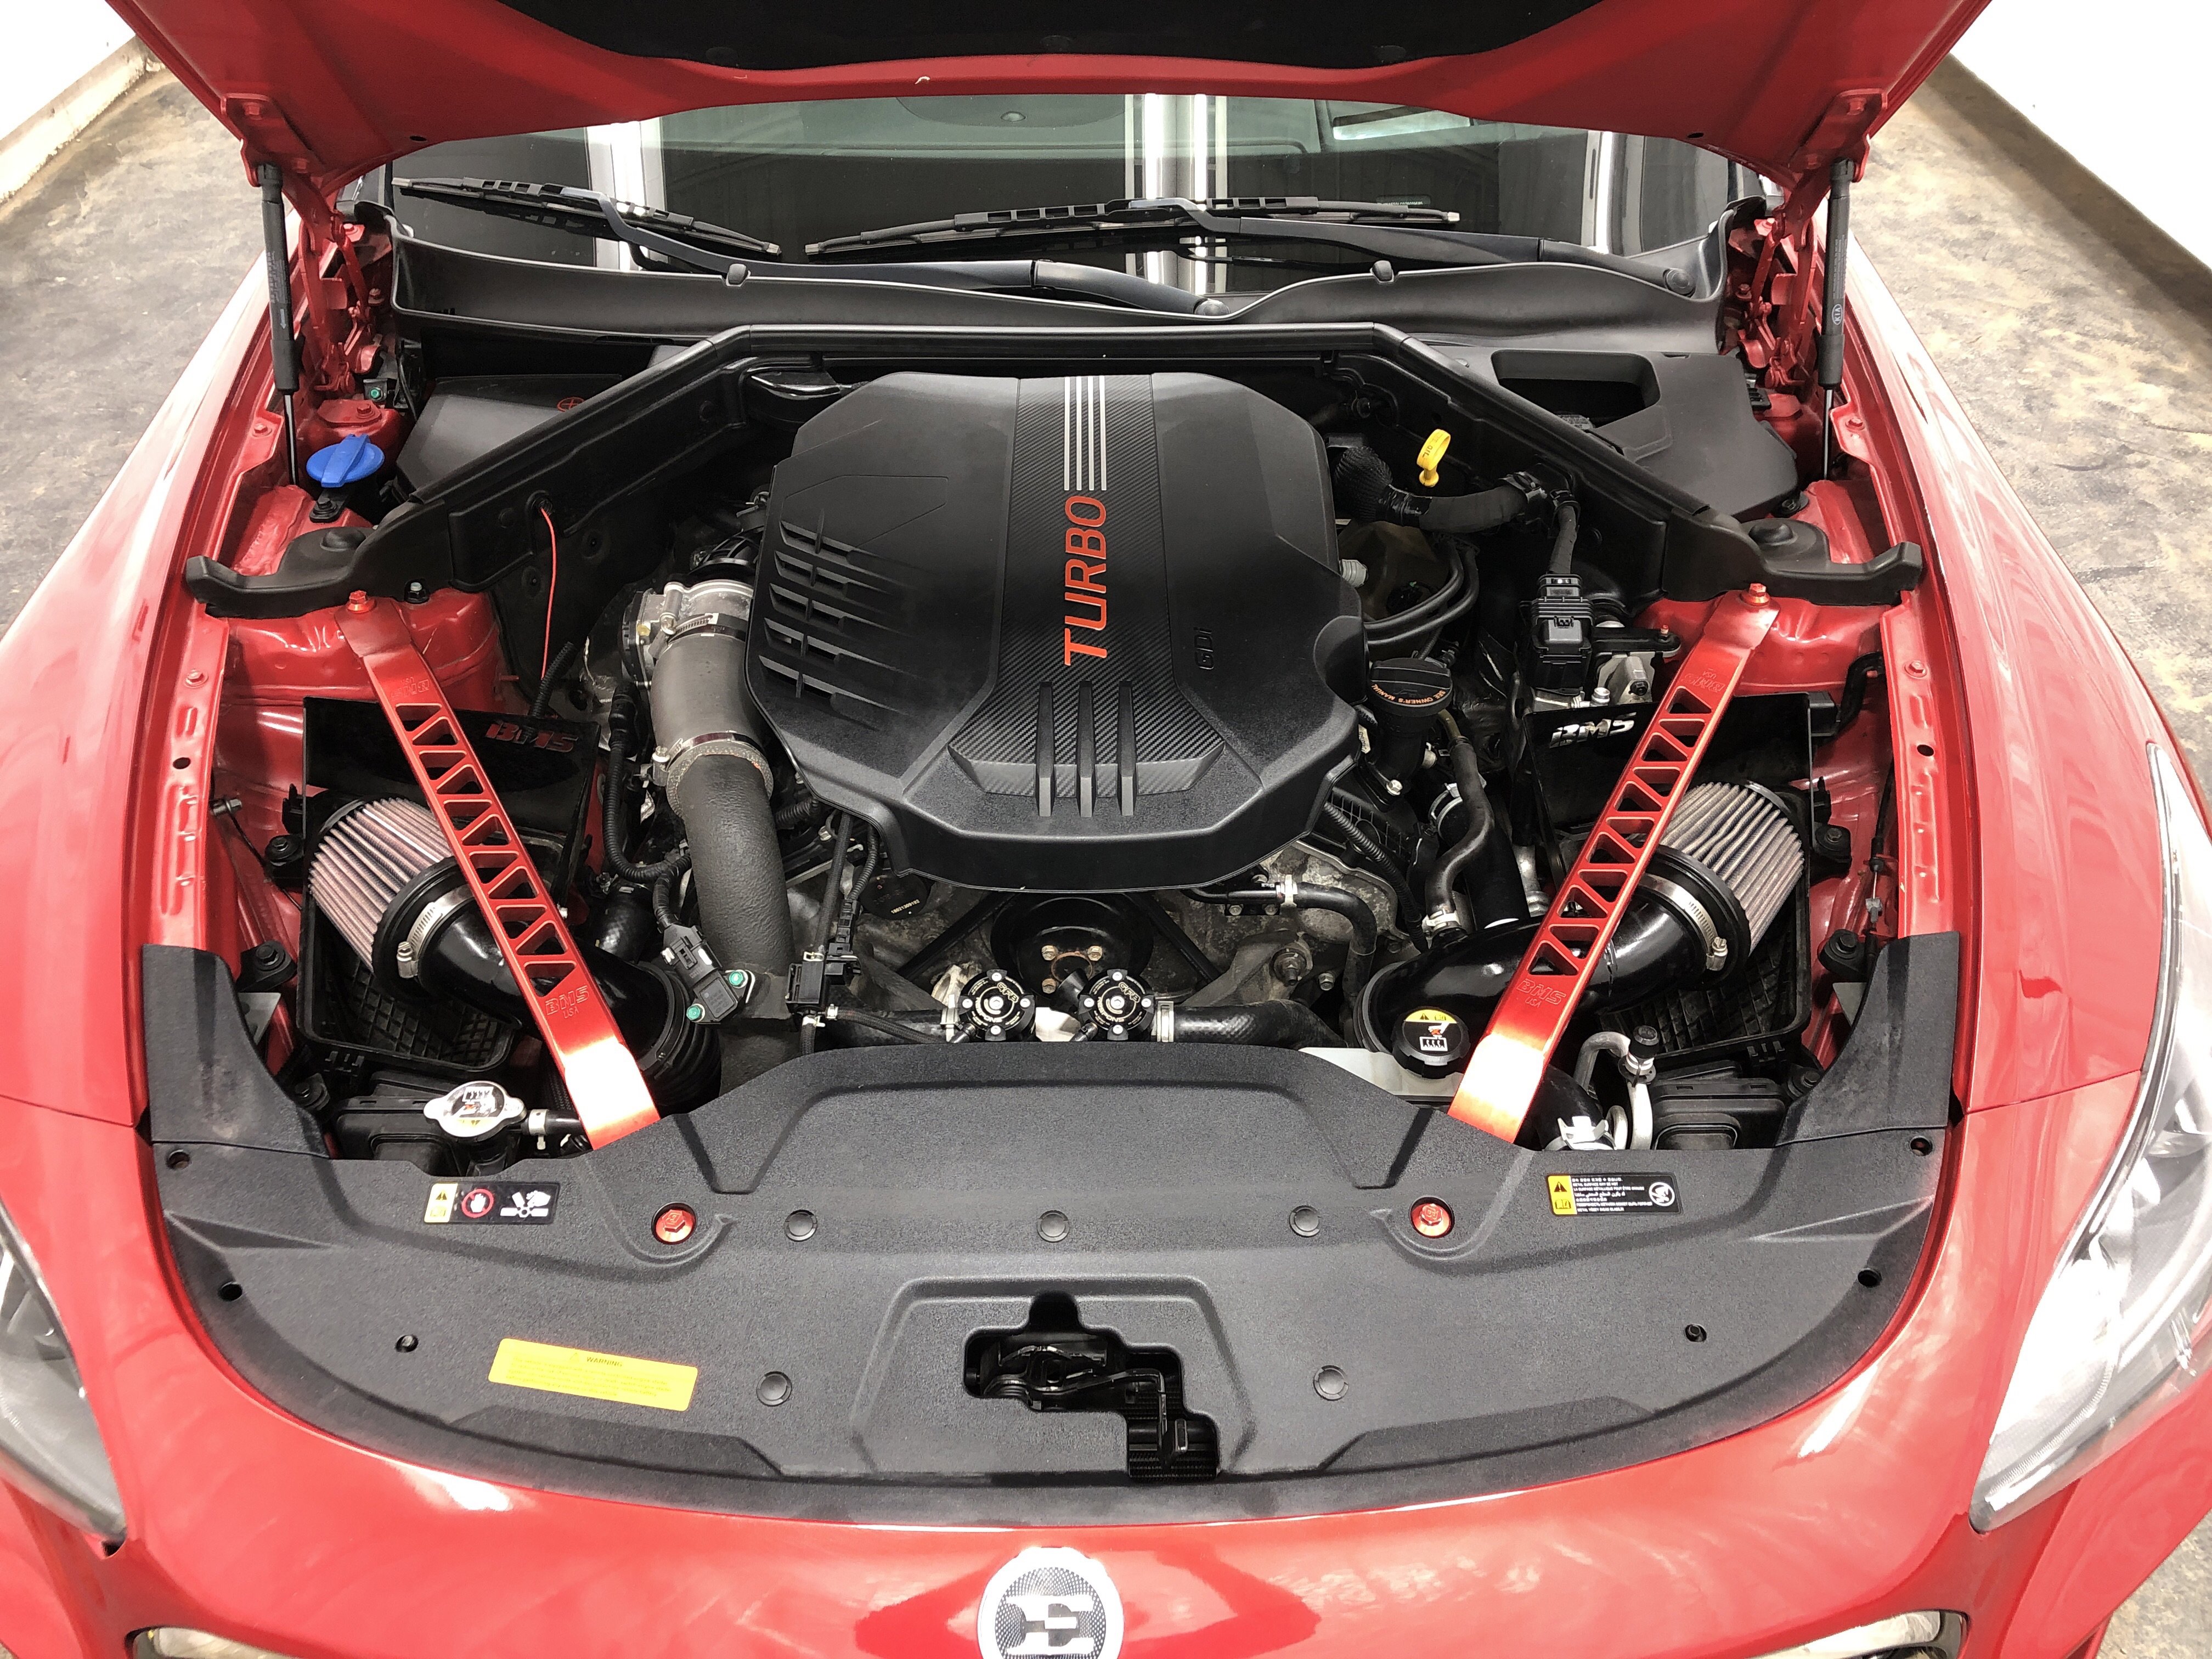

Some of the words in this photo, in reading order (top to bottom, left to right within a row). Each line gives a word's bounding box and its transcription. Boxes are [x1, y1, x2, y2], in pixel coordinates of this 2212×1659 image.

[1064, 495, 1108, 666] TURBO
[1433, 690, 1446, 699] SEE
[1549, 712, 1637, 748] BMS
[545, 985, 590, 1015] BMS
[1118, 981, 1141, 1003] GFB
[1516, 978, 1567, 1005] BMS
[1525, 996, 1542, 1008] USA
[562, 1006, 579, 1019] USA
[586, 1356, 623, 1367] WARNING
